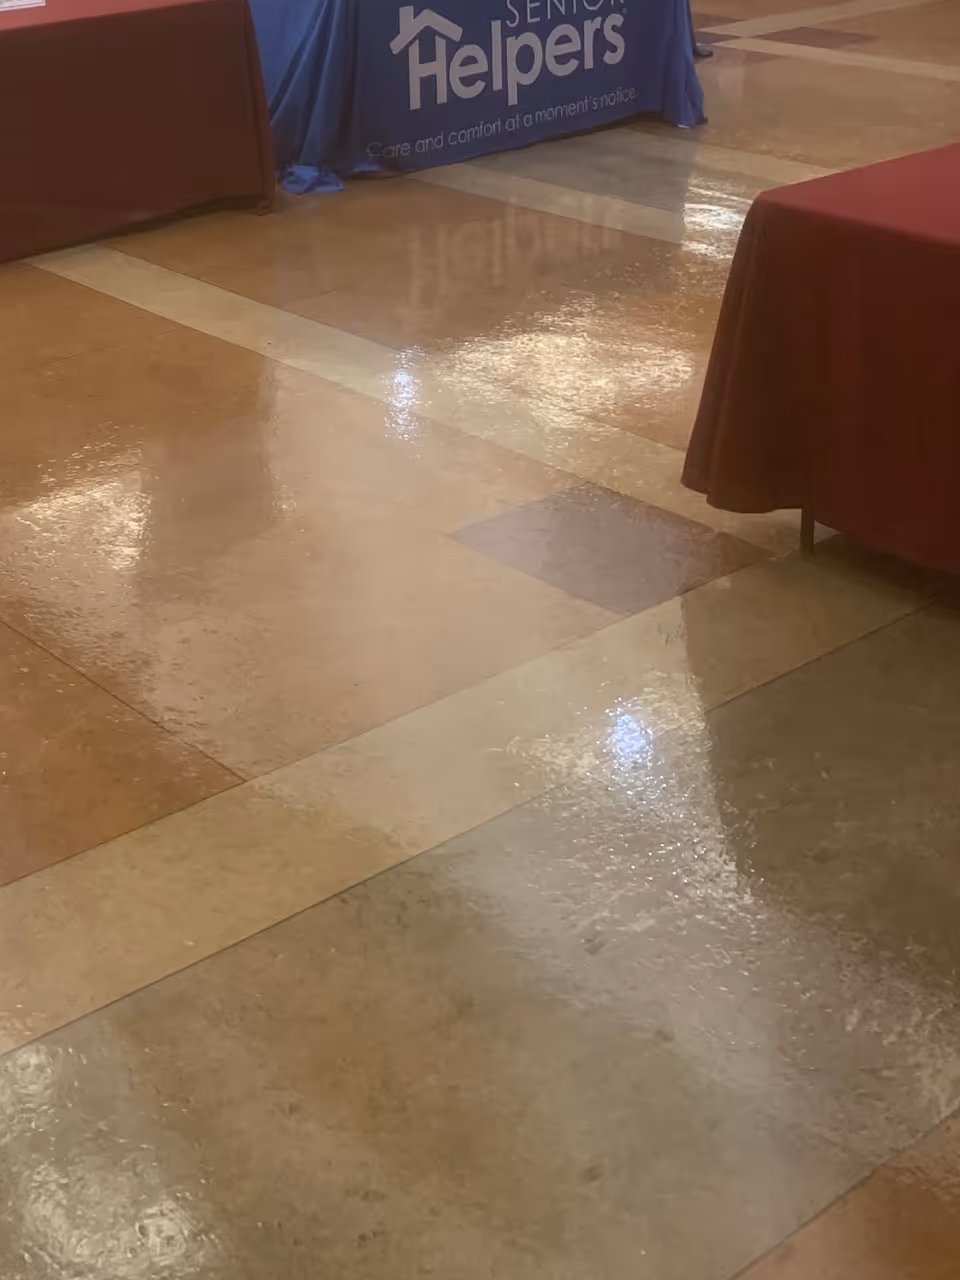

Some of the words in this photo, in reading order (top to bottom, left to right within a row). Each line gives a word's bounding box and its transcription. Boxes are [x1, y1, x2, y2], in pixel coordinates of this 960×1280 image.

[408, 12, 626, 111] Helpers
[367, 141, 411, 159] Care
[415, 131, 444, 155] and
[447, 117, 502, 146] comfort
[505, 113, 520, 131] at
[523, 111, 533, 127] a
[535, 96, 599, 124] moment's
